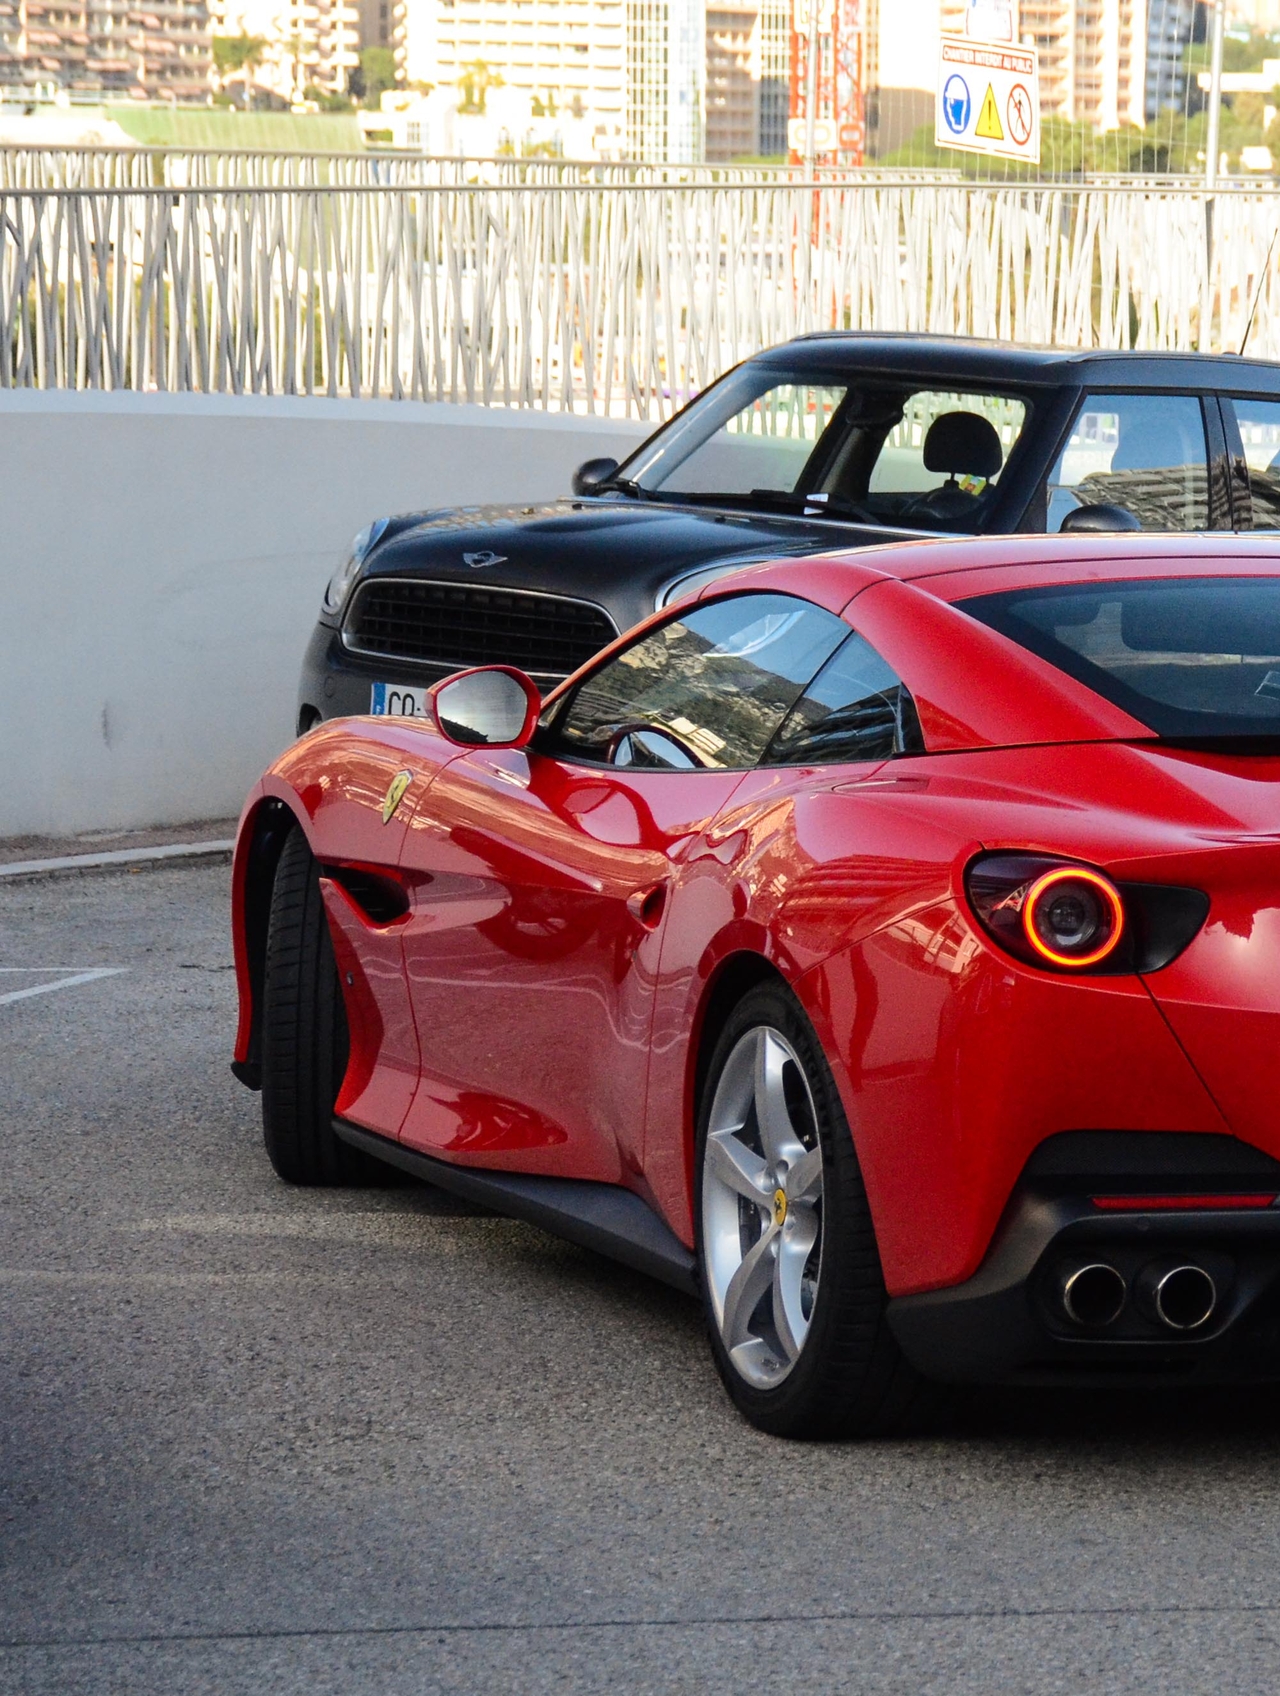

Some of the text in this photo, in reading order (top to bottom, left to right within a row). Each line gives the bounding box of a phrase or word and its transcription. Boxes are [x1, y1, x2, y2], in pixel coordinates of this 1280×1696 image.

[944, 46, 1032, 74] CHANTIER INTERDIT AU PUBLIC
